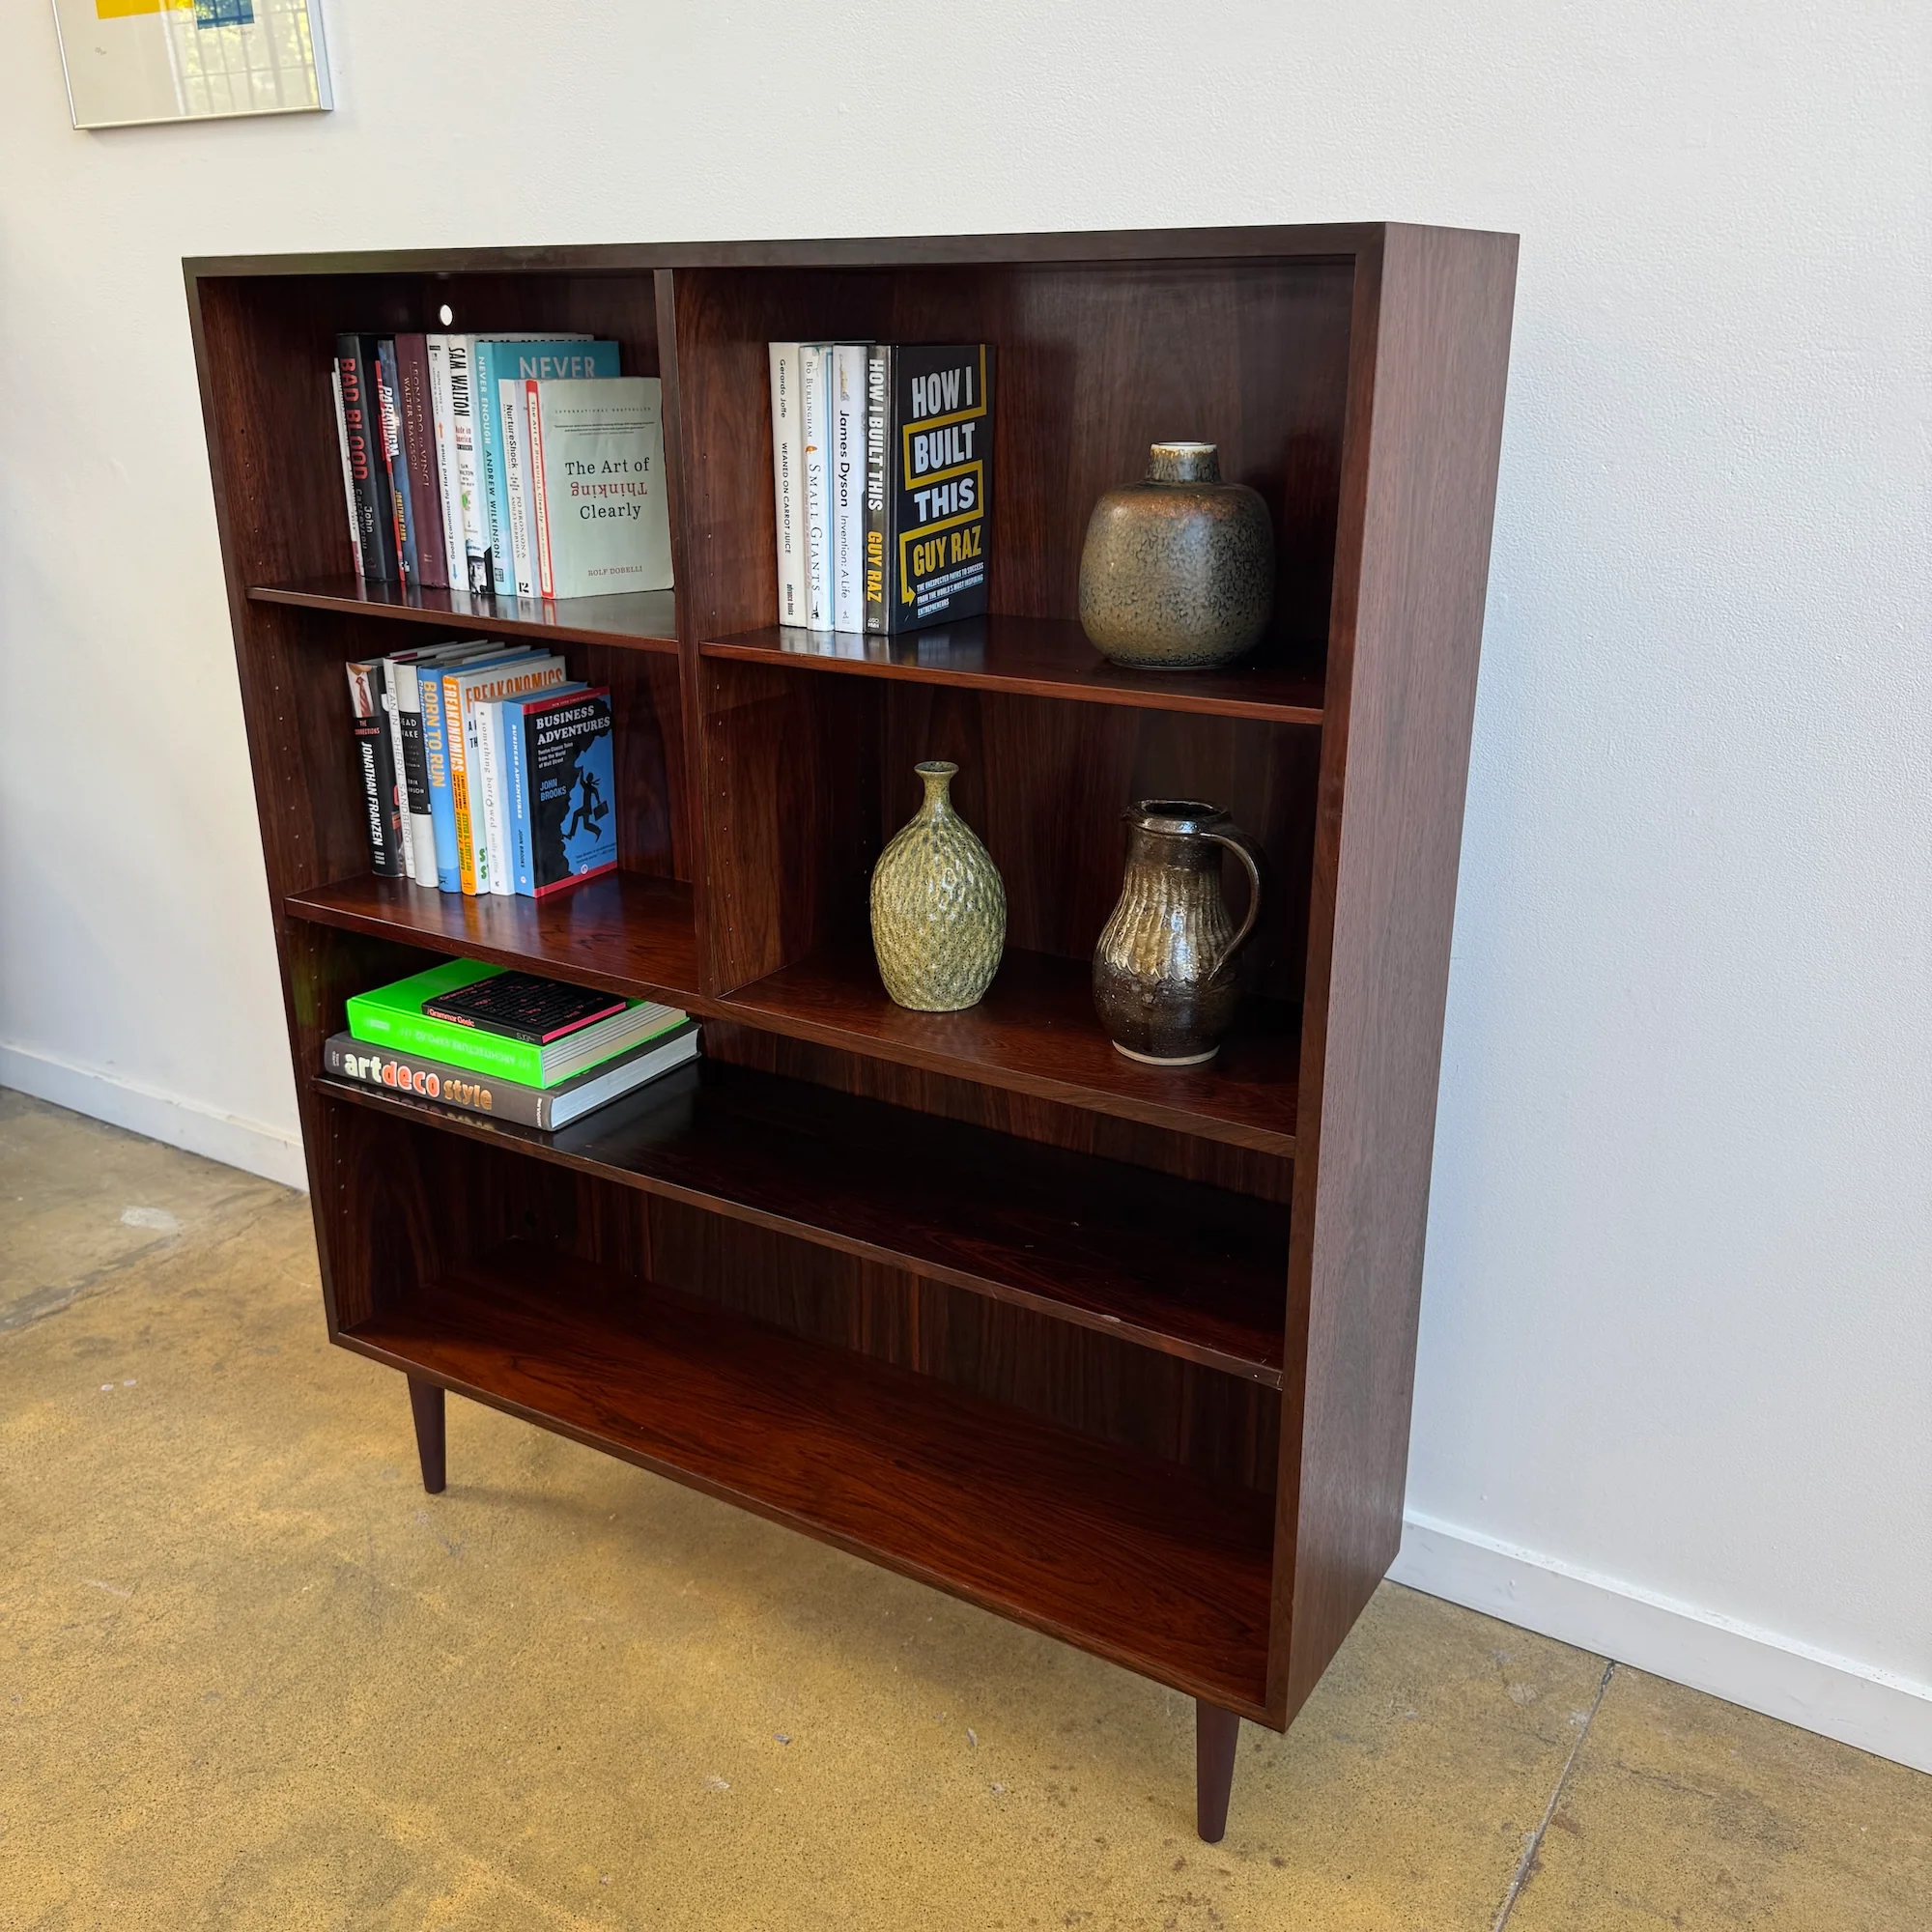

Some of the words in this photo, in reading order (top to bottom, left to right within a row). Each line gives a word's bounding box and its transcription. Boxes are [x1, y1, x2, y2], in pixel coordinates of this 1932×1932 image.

[448, 347, 467, 369] SAM
[478, 356, 487, 392] NEVER
[519, 356, 595, 379] NEVER
[806, 361, 813, 375] BO
[340, 358, 359, 402] BAD
[404, 378, 413, 417] WALTER
[451, 375, 470, 416] WALTON
[868, 358, 884, 402] HOW
[911, 368, 960, 418] HOW
[965, 366, 973, 406] I
[412, 361, 423, 432] LEONARDO
[420, 450, 429, 486] VINCI
[481, 398, 492, 444] ENOUGH
[506, 404, 519, 469] NurtureShock
[839, 410, 850, 458] James
[868, 416, 884, 467] BUILT
[346, 410, 368, 480] BLOOD
[408, 421, 417, 470] ISAACSON
[565, 461, 596, 475] The
[601, 459, 629, 473] Art
[634, 457, 650, 472] of
[914, 421, 976, 474] BUILT
[485, 450, 496, 496] ANDREW
[570, 481, 648, 498] Thinking
[782, 480, 789, 494] ON
[809, 464, 821, 520] SMALL
[838, 462, 850, 507] Dyson
[867, 470, 884, 511] THIS
[364, 506, 374, 533] John
[446, 500, 455, 540] Economics
[580, 502, 641, 520] Clearly
[914, 477, 975, 523] THIS
[490, 500, 501, 558] WILKINSON
[840, 515, 850, 567] Invention:
[867, 531, 883, 567] GUY
[588, 568, 608, 577] ROLF
[610, 566, 642, 575] DOBELLI
[810, 526, 823, 591] GIANTS
[913, 536, 947, 577] GUY
[951, 525, 981, 564] RAZ
[840, 569, 849, 578] A
[840, 581, 850, 599] Life
[867, 569, 882, 603] RAZ
[387, 680, 397, 710] LEAN
[424, 681, 440, 727] BORN
[391, 714, 399, 726] IN
[401, 718, 417, 726] EAD
[443, 683, 464, 772] FREAKONOMICS
[535, 705, 595, 730] BUSINESS
[537, 716, 611, 746] ADVENTURES
[393, 737, 405, 780] SHERYL
[427, 729, 442, 751] TO
[360, 741, 378, 796] JONATHAN
[430, 753, 446, 787] RUN
[540, 778, 557, 791] JOHN
[398, 783, 412, 843] SANDBERG
[514, 767, 523, 819] ADVENTURES
[541, 785, 567, 802] BROOKS
[367, 797, 384, 846] FRANZEN
[344, 1053, 440, 1097] artdeco
[443, 1079, 493, 1111] style
